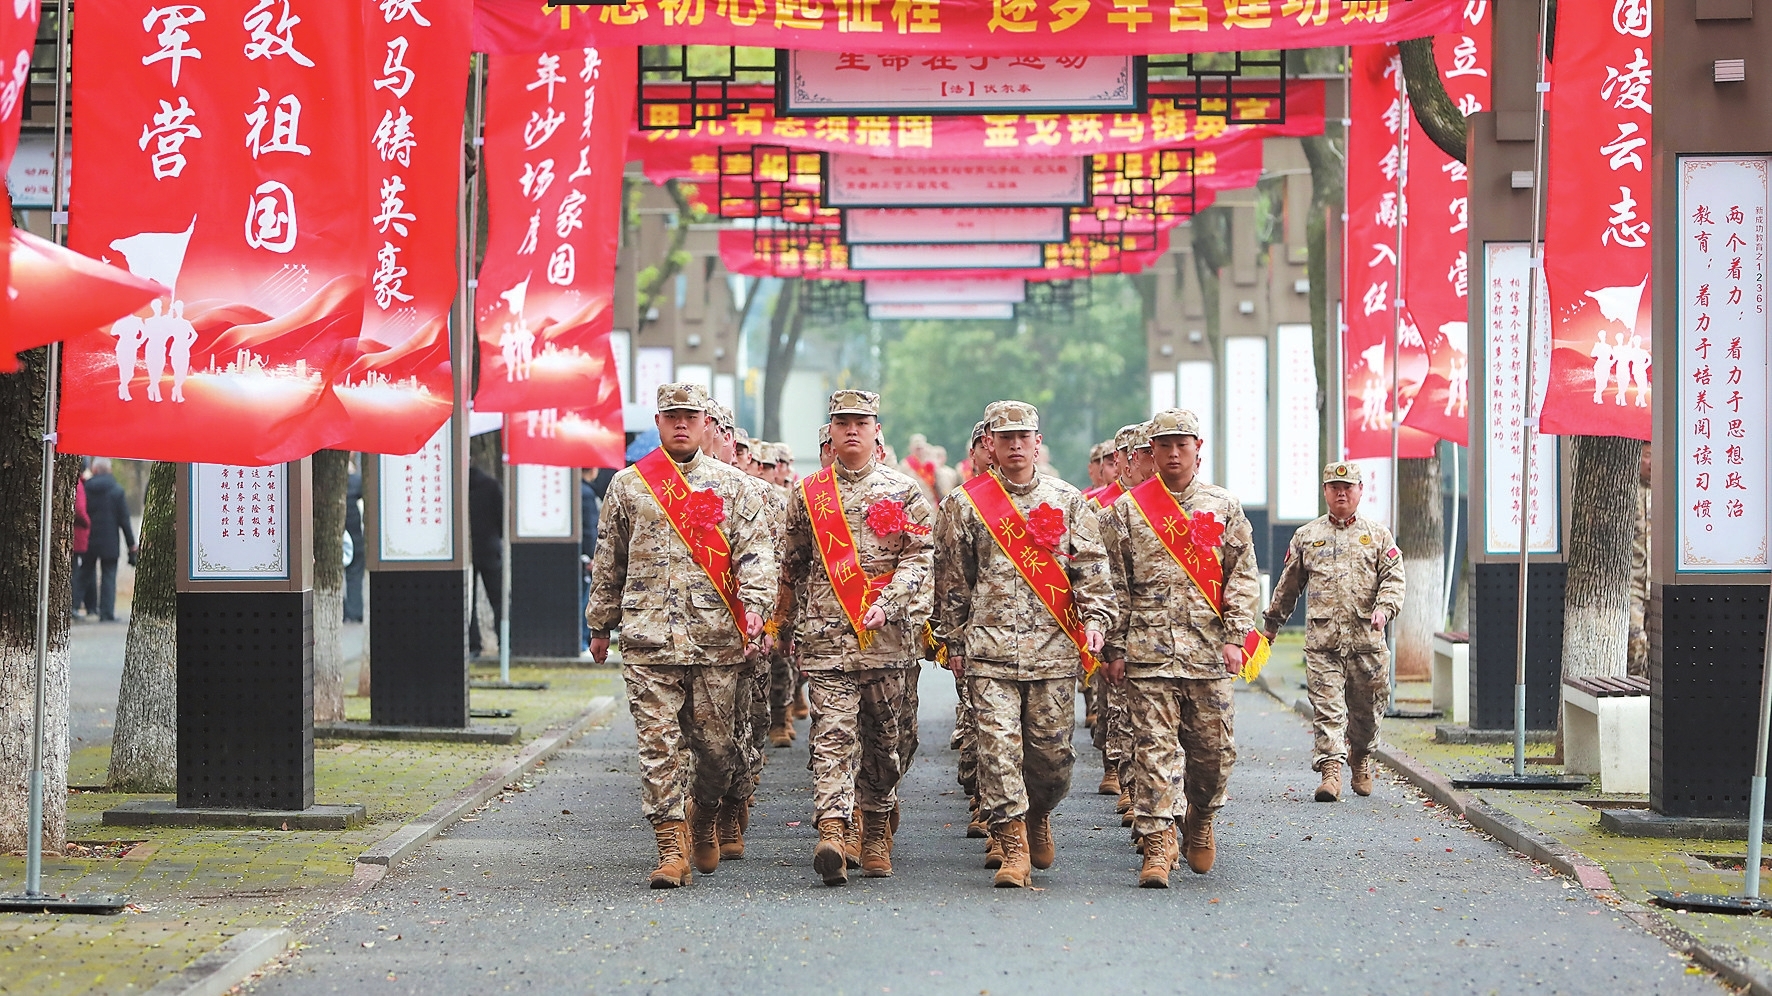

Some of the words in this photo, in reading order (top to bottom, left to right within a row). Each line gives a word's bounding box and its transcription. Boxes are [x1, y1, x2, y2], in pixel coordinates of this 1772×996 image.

[138, 5, 206, 181] 军营
[243, 0, 315, 254] 效祖国
[1755, 206, 1764, 314] 新成功教育之12365
